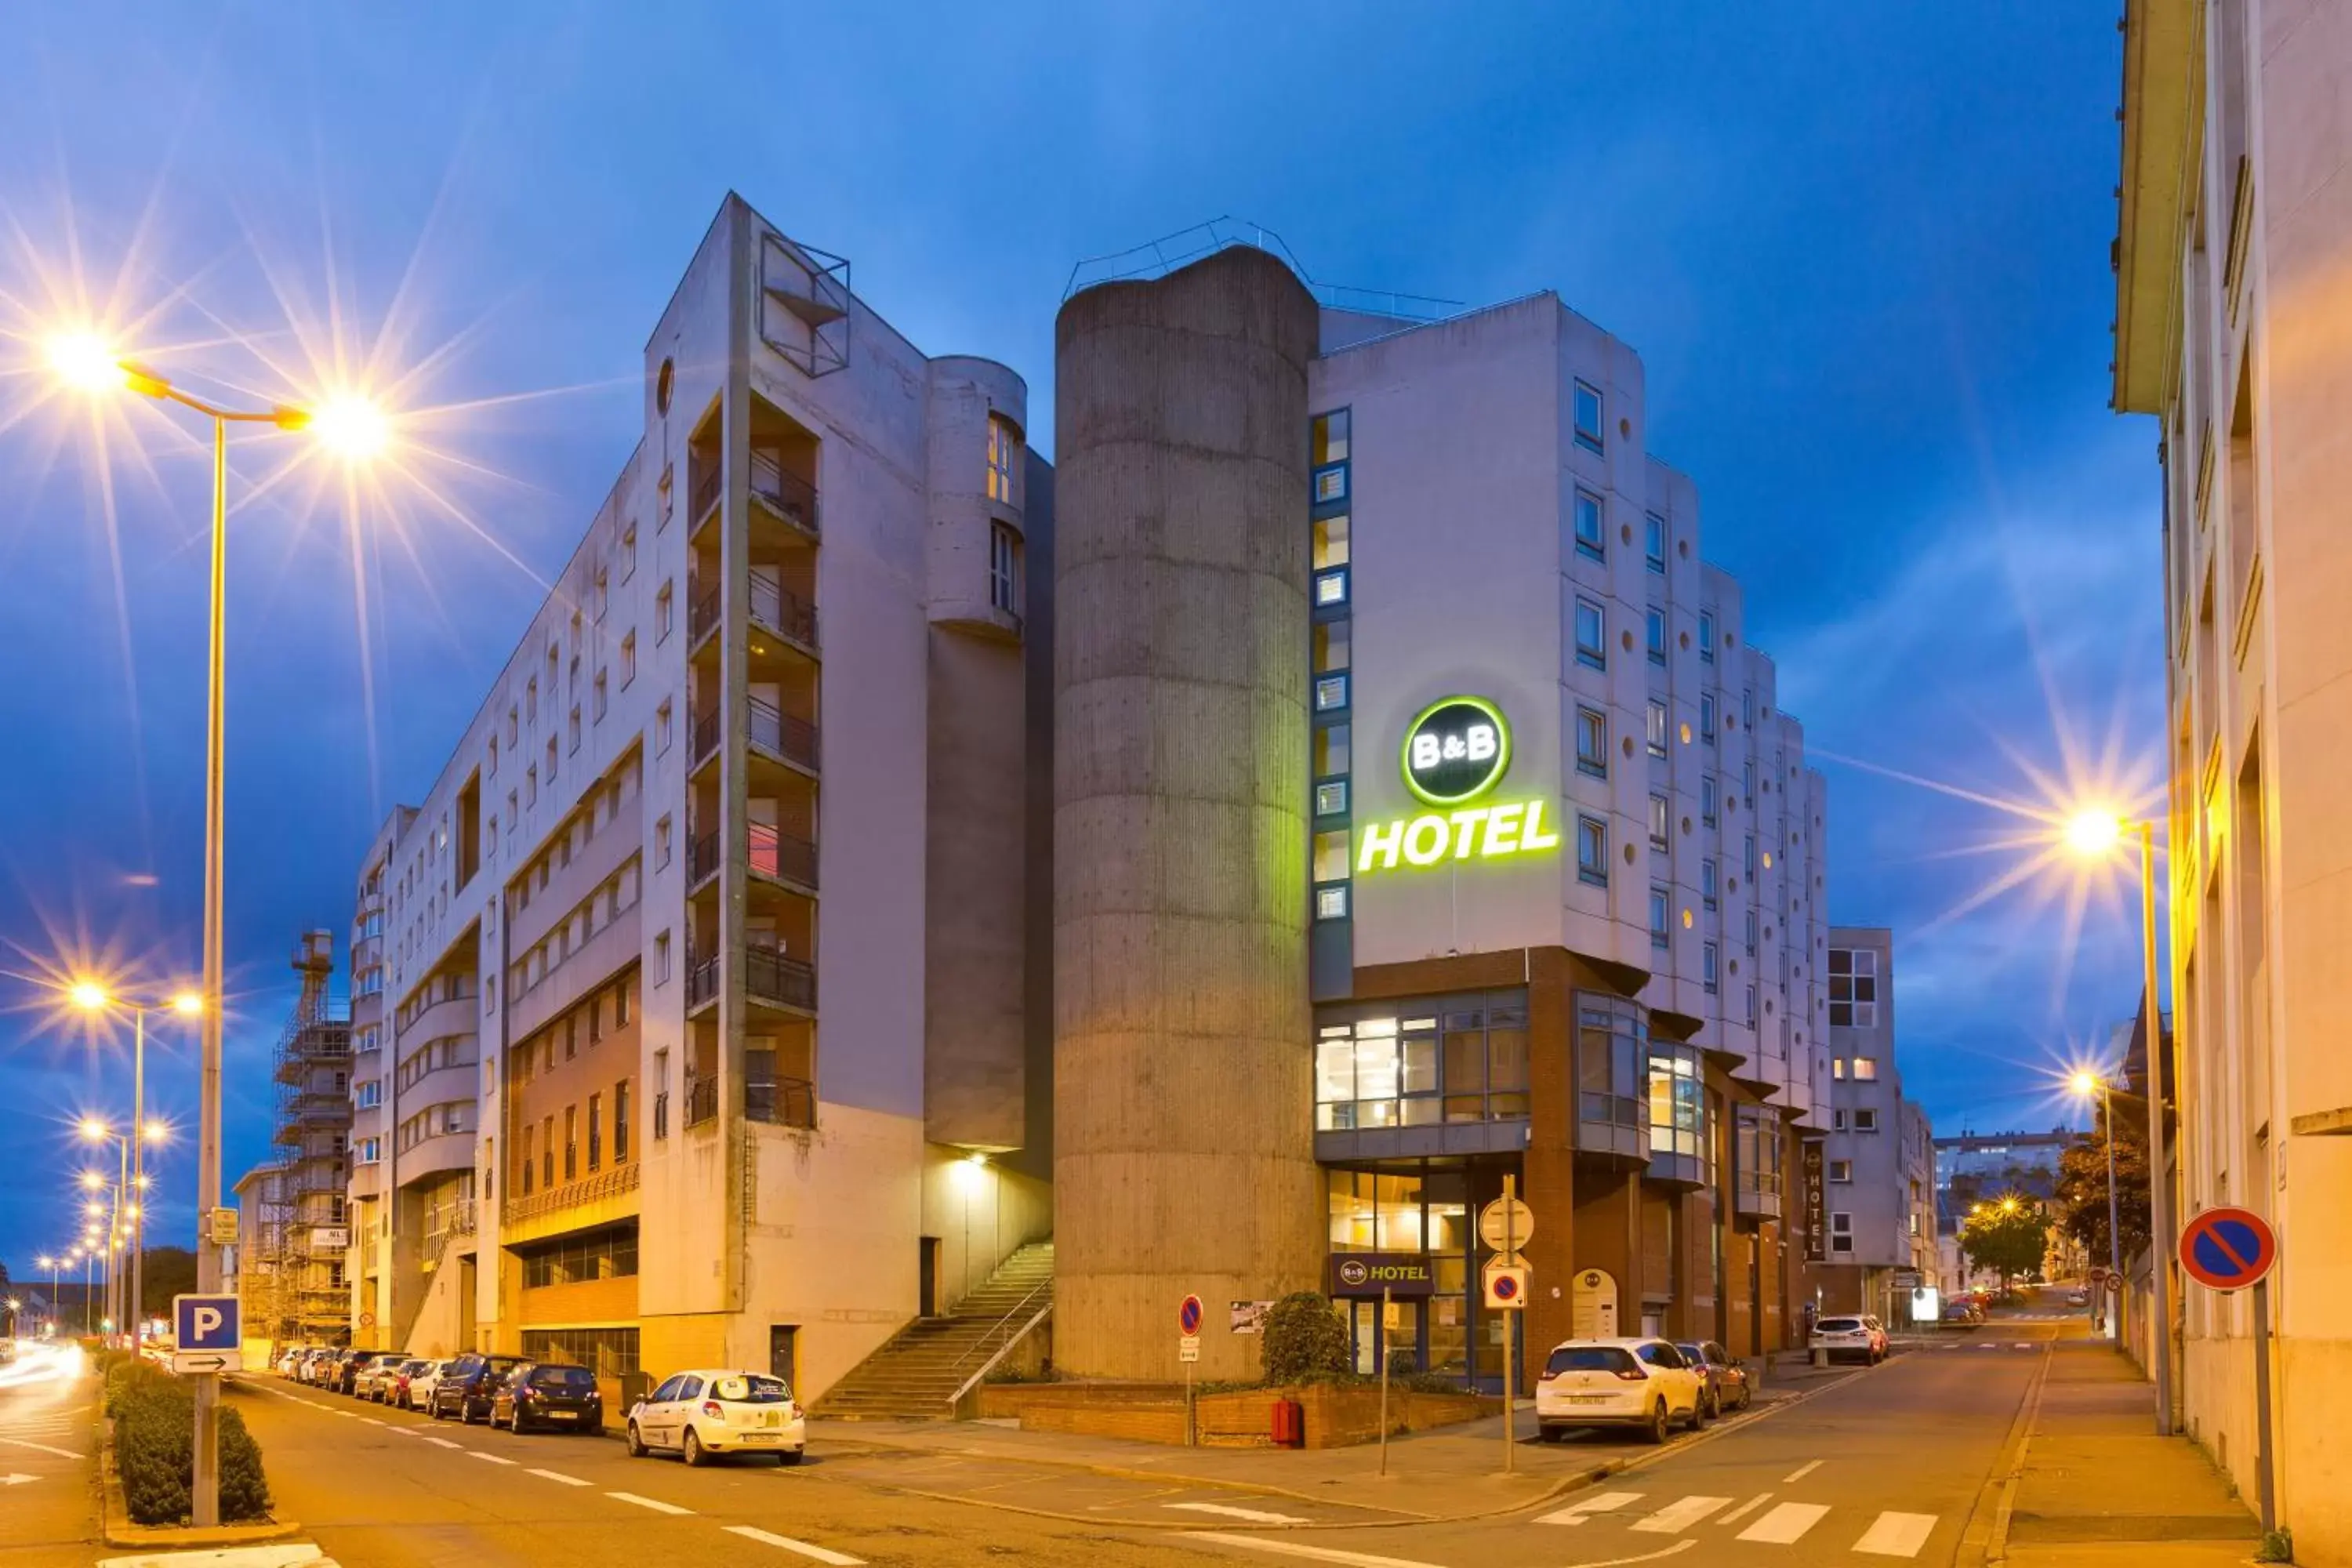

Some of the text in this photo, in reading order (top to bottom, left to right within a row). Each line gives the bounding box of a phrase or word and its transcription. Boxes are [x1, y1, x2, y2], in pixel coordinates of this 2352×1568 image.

[1414, 725, 1497, 770] B&B
[1357, 800, 1559, 872] HOTEL
[1810, 1174, 1821, 1253] HOTEL
[1371, 1266, 1429, 1280] HOTEL
[194, 1307, 222, 1341] P
